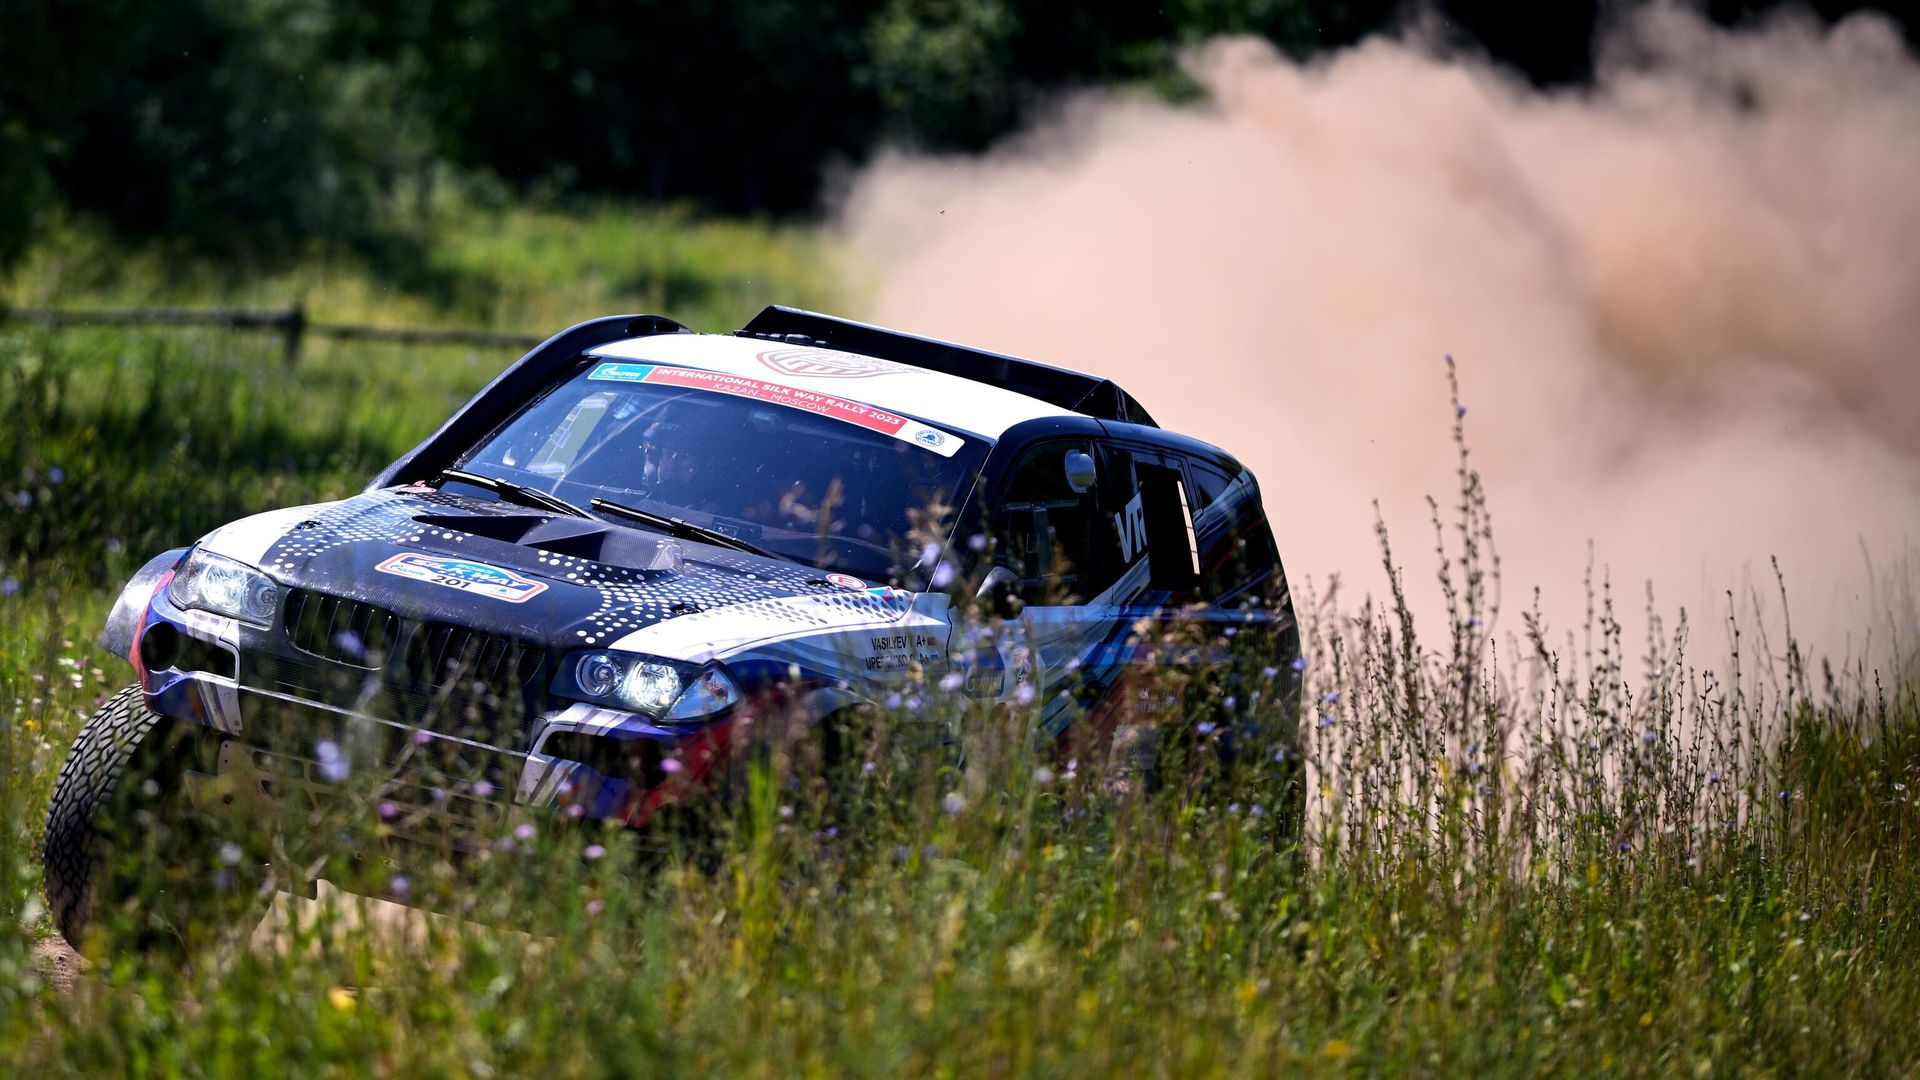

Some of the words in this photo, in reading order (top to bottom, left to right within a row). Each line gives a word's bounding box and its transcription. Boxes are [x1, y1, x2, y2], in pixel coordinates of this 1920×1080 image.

[657, 368, 759, 389] INTERNATIONAL
[761, 384, 791, 395] SILK
[794, 390, 825, 403] WAY
[824, 397, 867, 415] RALLY
[868, 410, 901, 425] 2023
[713, 383, 759, 396] KAZAN
[770, 393, 831, 413] MOSCOW
[430, 574, 472, 589] 201
[471, 571, 528, 588] WAY
[871, 635, 907, 651] VASILYEV
[916, 634, 926, 648] A+
